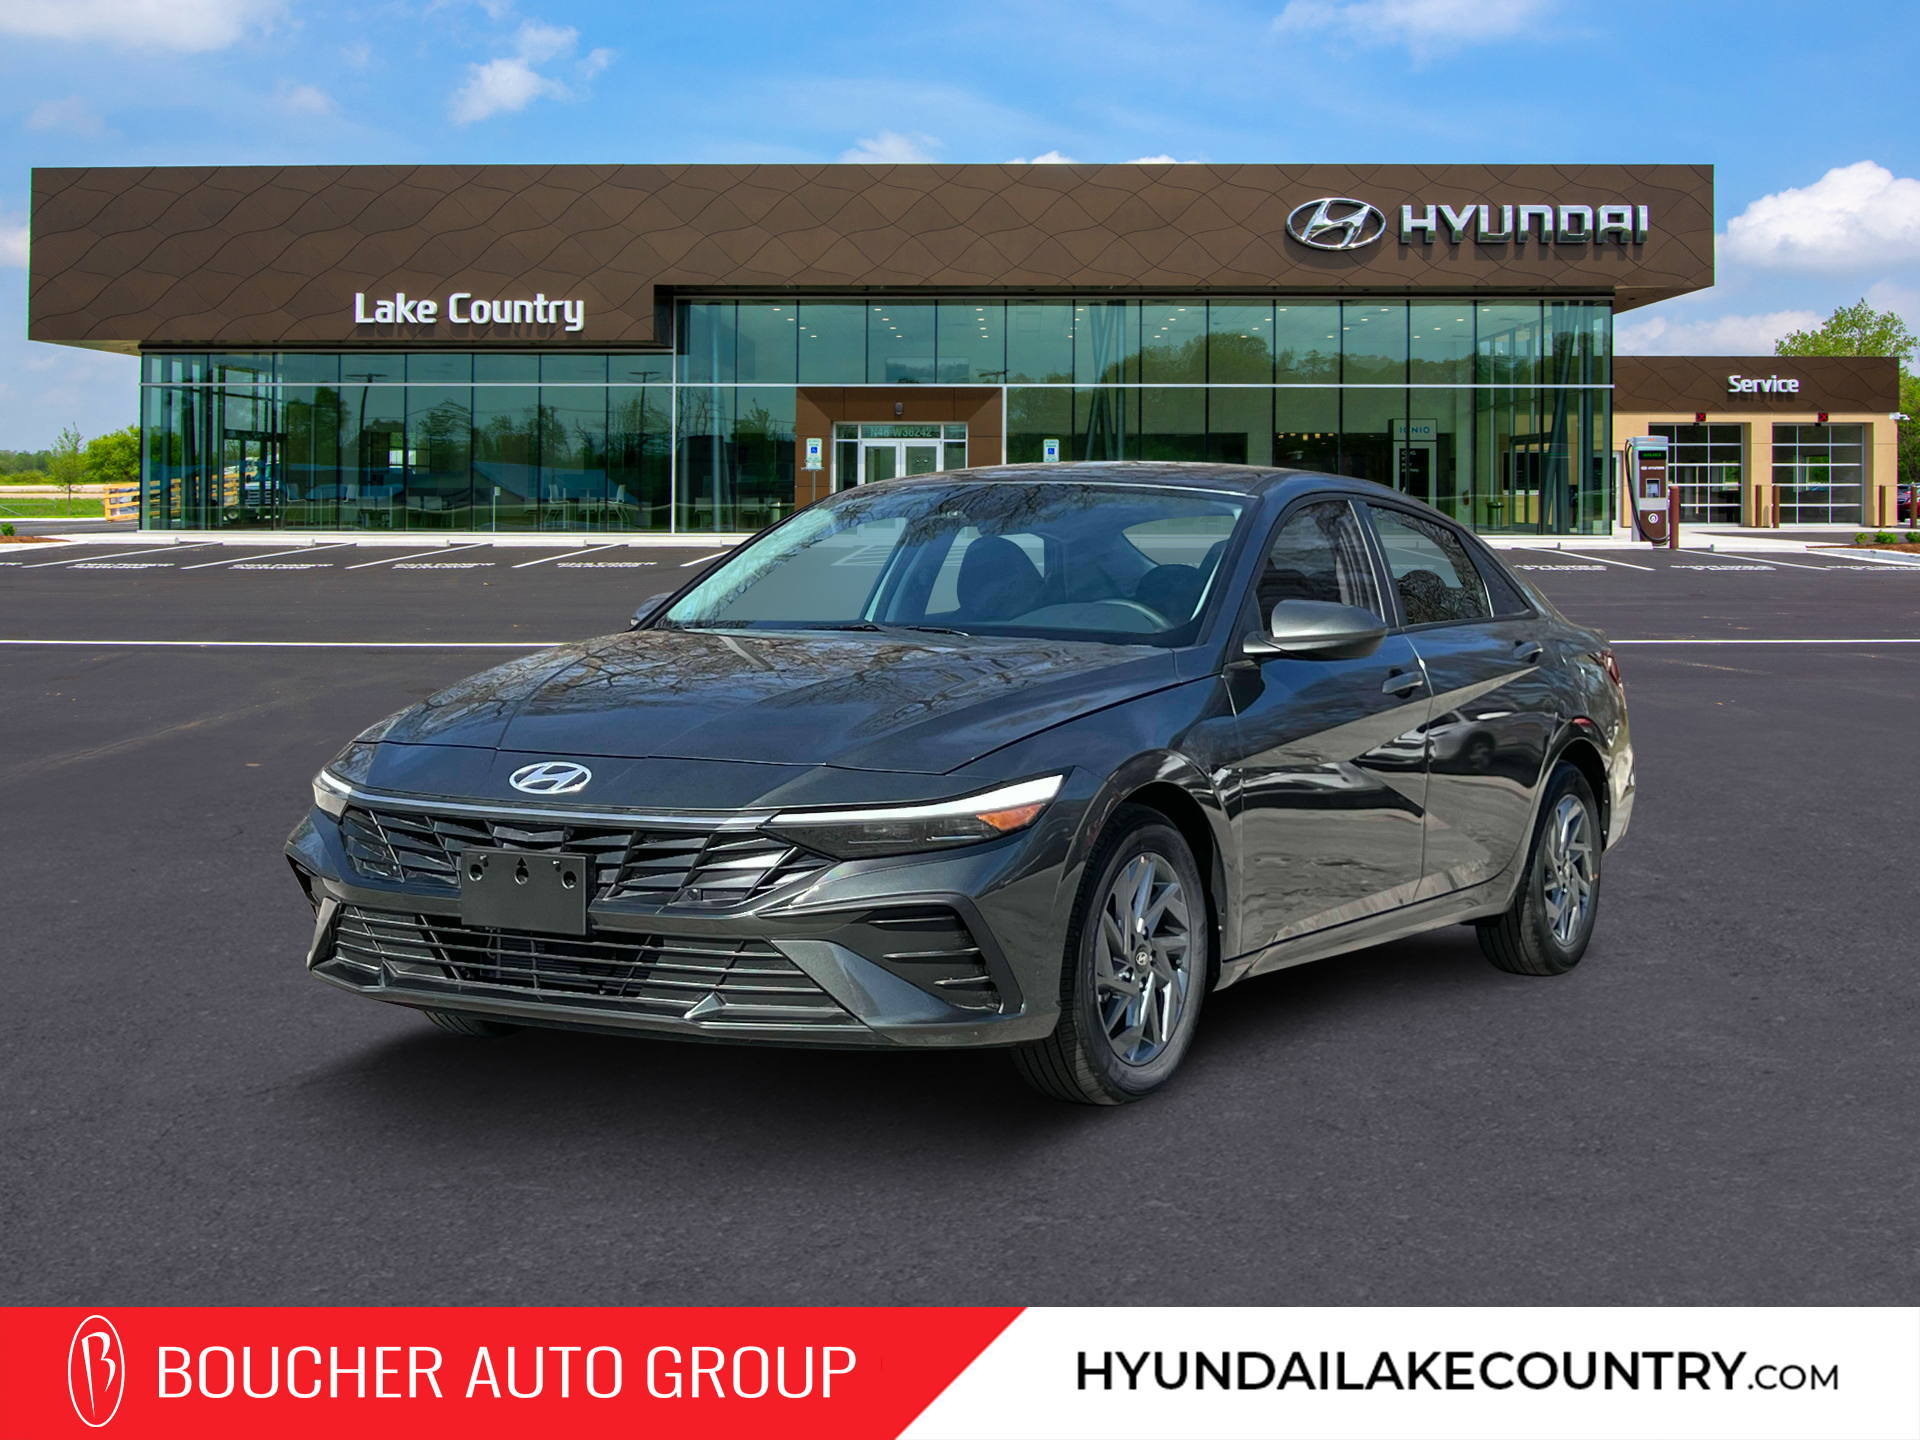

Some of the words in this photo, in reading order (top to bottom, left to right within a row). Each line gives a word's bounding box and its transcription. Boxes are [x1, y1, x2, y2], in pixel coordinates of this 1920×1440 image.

[1400, 204, 1649, 244] HYUNDAI
[354, 291, 438, 324] Lake
[448, 291, 585, 333] Country
[1727, 374, 1800, 394] Service
[869, 426, 890, 438] N48
[893, 426, 932, 438] W36242
